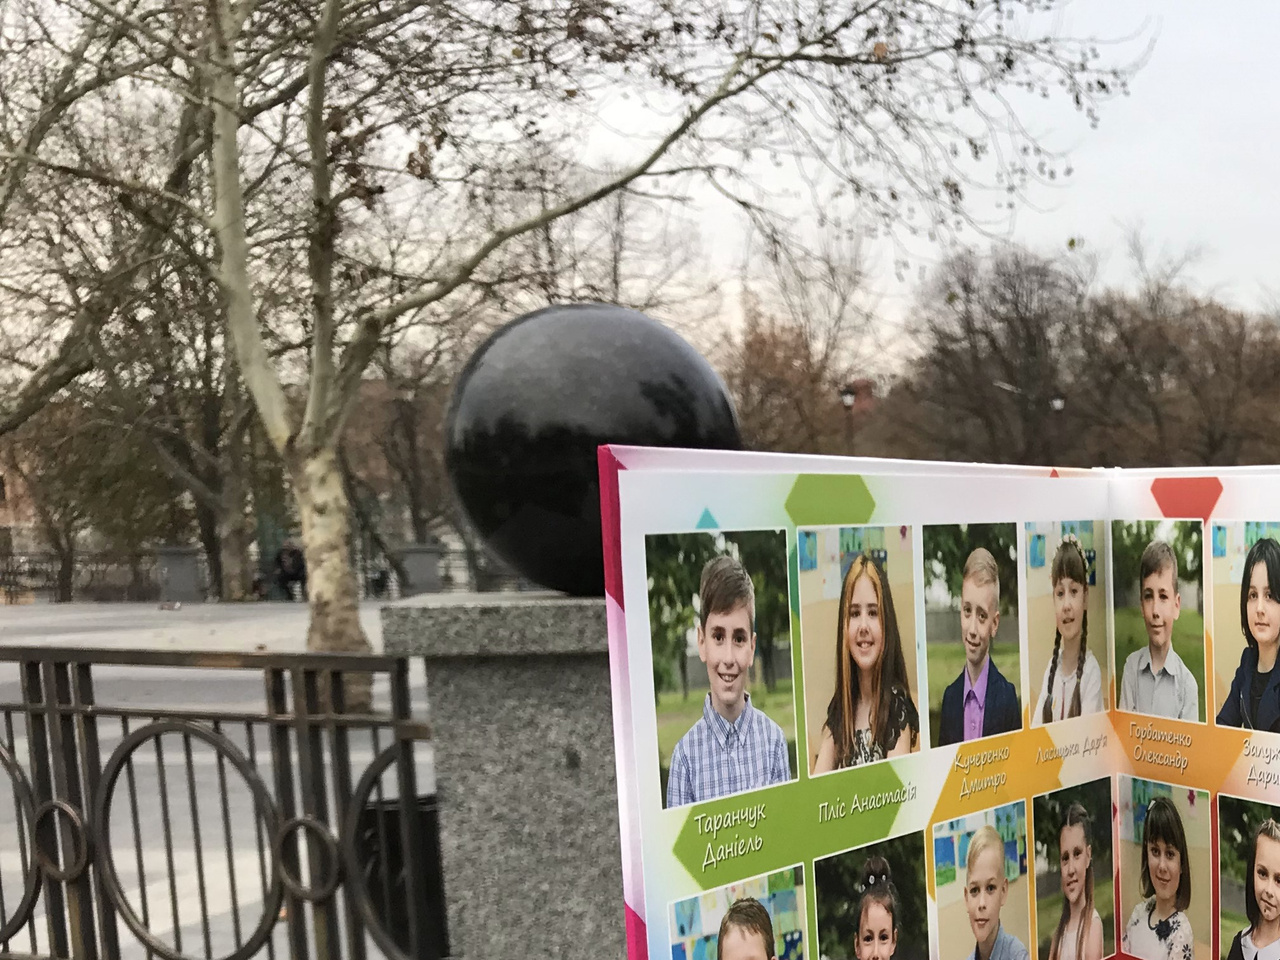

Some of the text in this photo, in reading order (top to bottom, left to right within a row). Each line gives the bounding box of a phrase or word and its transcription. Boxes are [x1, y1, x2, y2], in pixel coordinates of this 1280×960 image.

[1129, 721, 1192, 748] Горбатенко
[954, 746, 1010, 774] Кучеренко
[1133, 744, 1189, 774] Олександр
[959, 772, 1007, 800] Дмитро
[818, 783, 917, 823] Пліс Анастасія
[694, 803, 767, 839] Таранчук
[702, 834, 763, 872] Даніель
